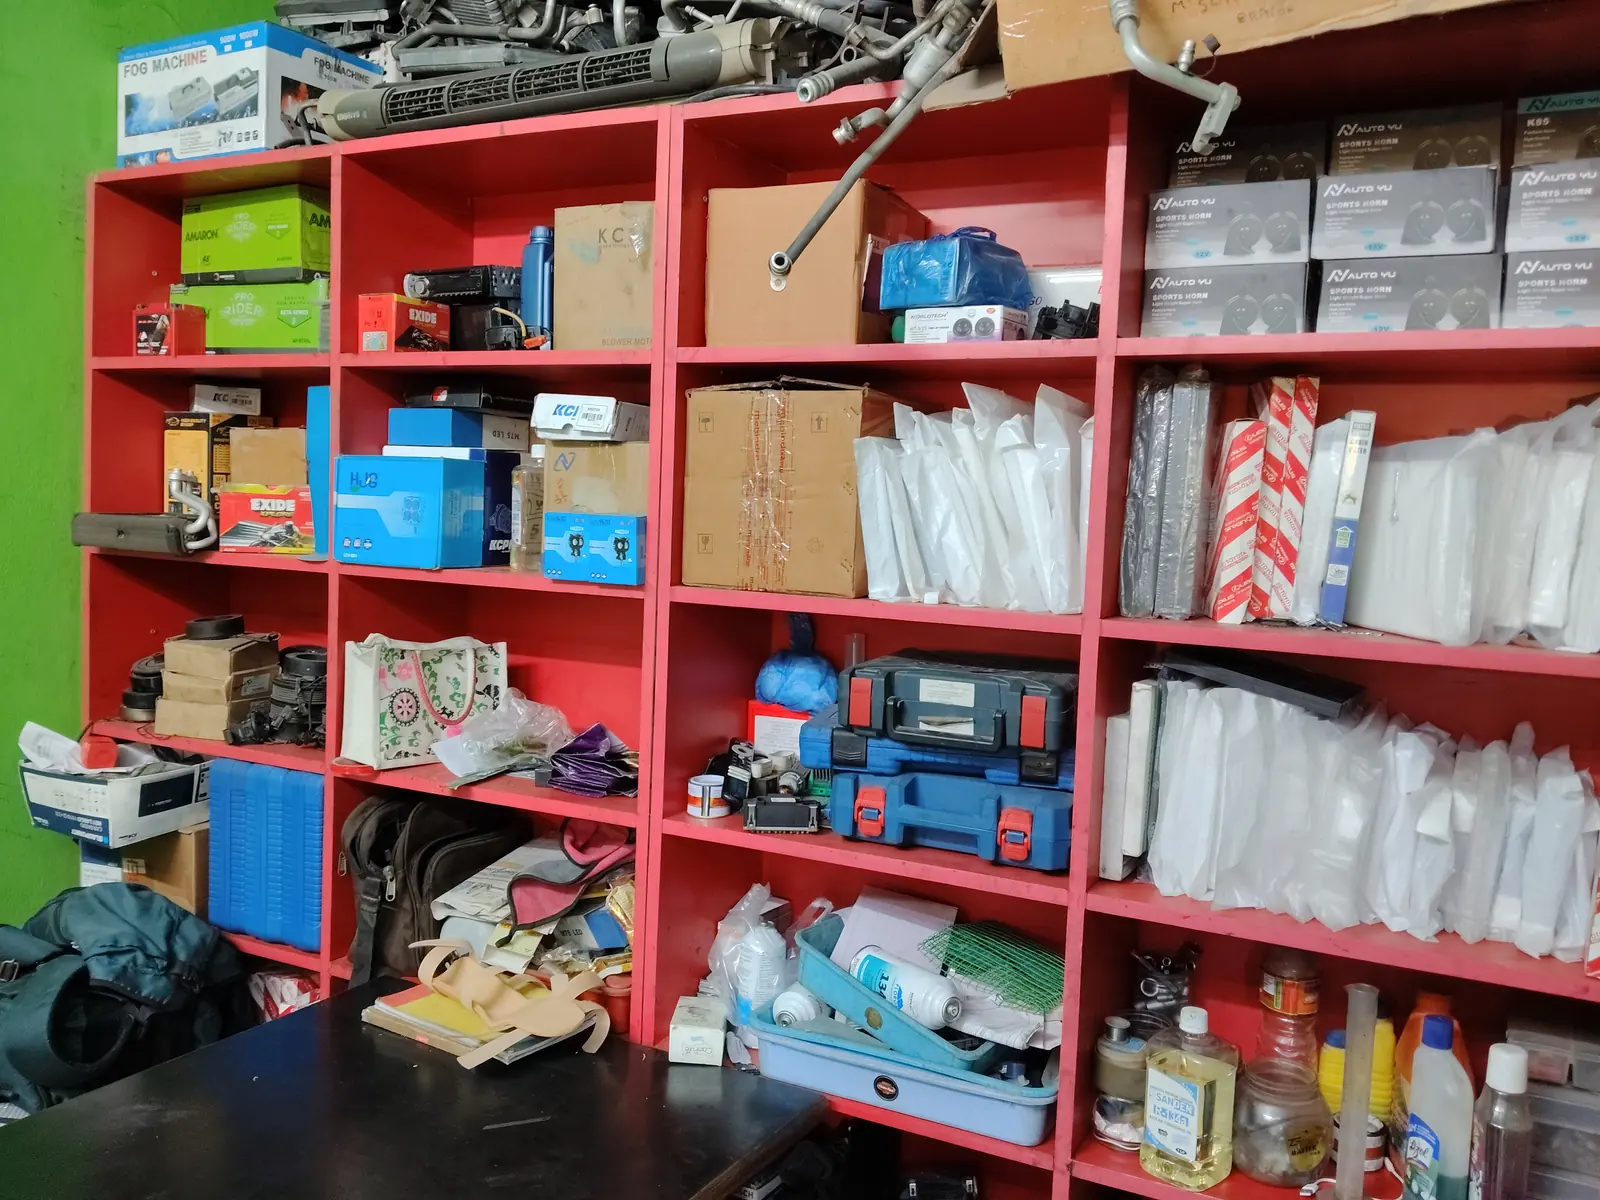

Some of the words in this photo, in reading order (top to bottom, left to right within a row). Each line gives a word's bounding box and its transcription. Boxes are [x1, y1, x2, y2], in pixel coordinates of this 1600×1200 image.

[123, 62, 148, 78] FOG
[152, 49, 208, 73] MACHINE
[314, 57, 331, 70] FOG
[1356, 125, 1385, 133] AUTO
[1387, 123, 1403, 131] YU
[1339, 140, 1372, 149] SPORTS
[1374, 138, 1399, 146] HORN
[1178, 157, 1208, 165] SPORTS
[1542, 172, 1577, 183] AUTO
[1579, 171, 1598, 180] YU
[1343, 185, 1374, 194] AUTO
[1376, 184, 1393, 192] YU
[1521, 189, 1561, 200] SPORTS
[1563, 187, 1593, 197] HORN
[1171, 199, 1199, 207] AUTO
[1326, 201, 1361, 210] SPORTS
[1362, 199, 1389, 208] HORN
[1155, 214, 1187, 223] SPORTS
[1188, 212, 1212, 220] HORN
[184, 228, 219, 242] AMARON
[1537, 263, 1572, 272] AUTO
[1574, 262, 1593, 270] YU
[1347, 271, 1378, 280] AUTO
[1380, 271, 1397, 279] YU
[1168, 279, 1196, 287] AUTO
[1518, 279, 1556, 288] SPORTS
[1558, 277, 1588, 286] HORN
[1329, 286, 1364, 295] SPORTS
[1366, 285, 1393, 293] HORN
[1152, 293, 1184, 301] SPORTS
[1185, 292, 1209, 300] HORN
[408, 308, 437, 325] EXIDE
[601, 338, 632, 347] BLOWER
[492, 430, 505, 438] LED
[249, 498, 296, 512] EXIDE
[573, 928, 583, 936] LED
